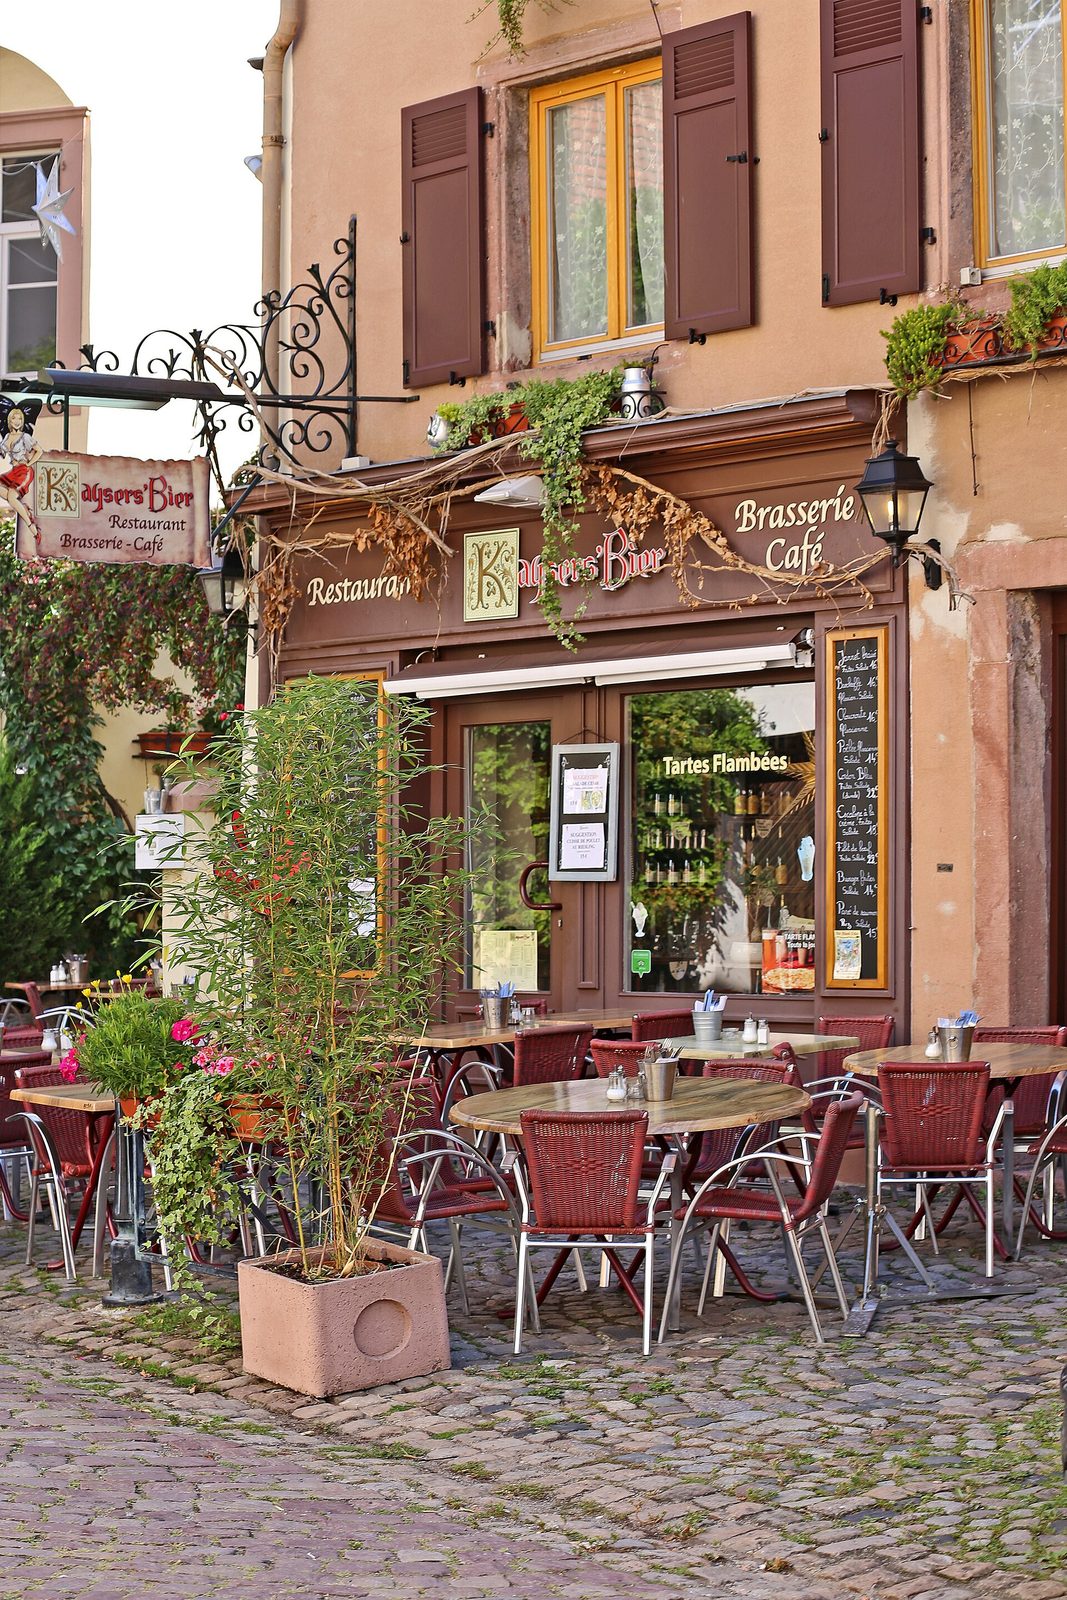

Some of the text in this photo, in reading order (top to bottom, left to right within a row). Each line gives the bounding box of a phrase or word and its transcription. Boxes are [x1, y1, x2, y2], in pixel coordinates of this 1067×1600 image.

[735, 484, 855, 533] Brasserie
[108, 514, 187, 531] Restaurant
[60, 533, 123, 549] Brasserie
[134, 534, 164, 558] Café
[766, 525, 825, 576] Café
[307, 575, 411, 605] Restauran
[662, 751, 788, 775] Tartes Flambées
[837, 766, 873, 781] Cordon Bleu
